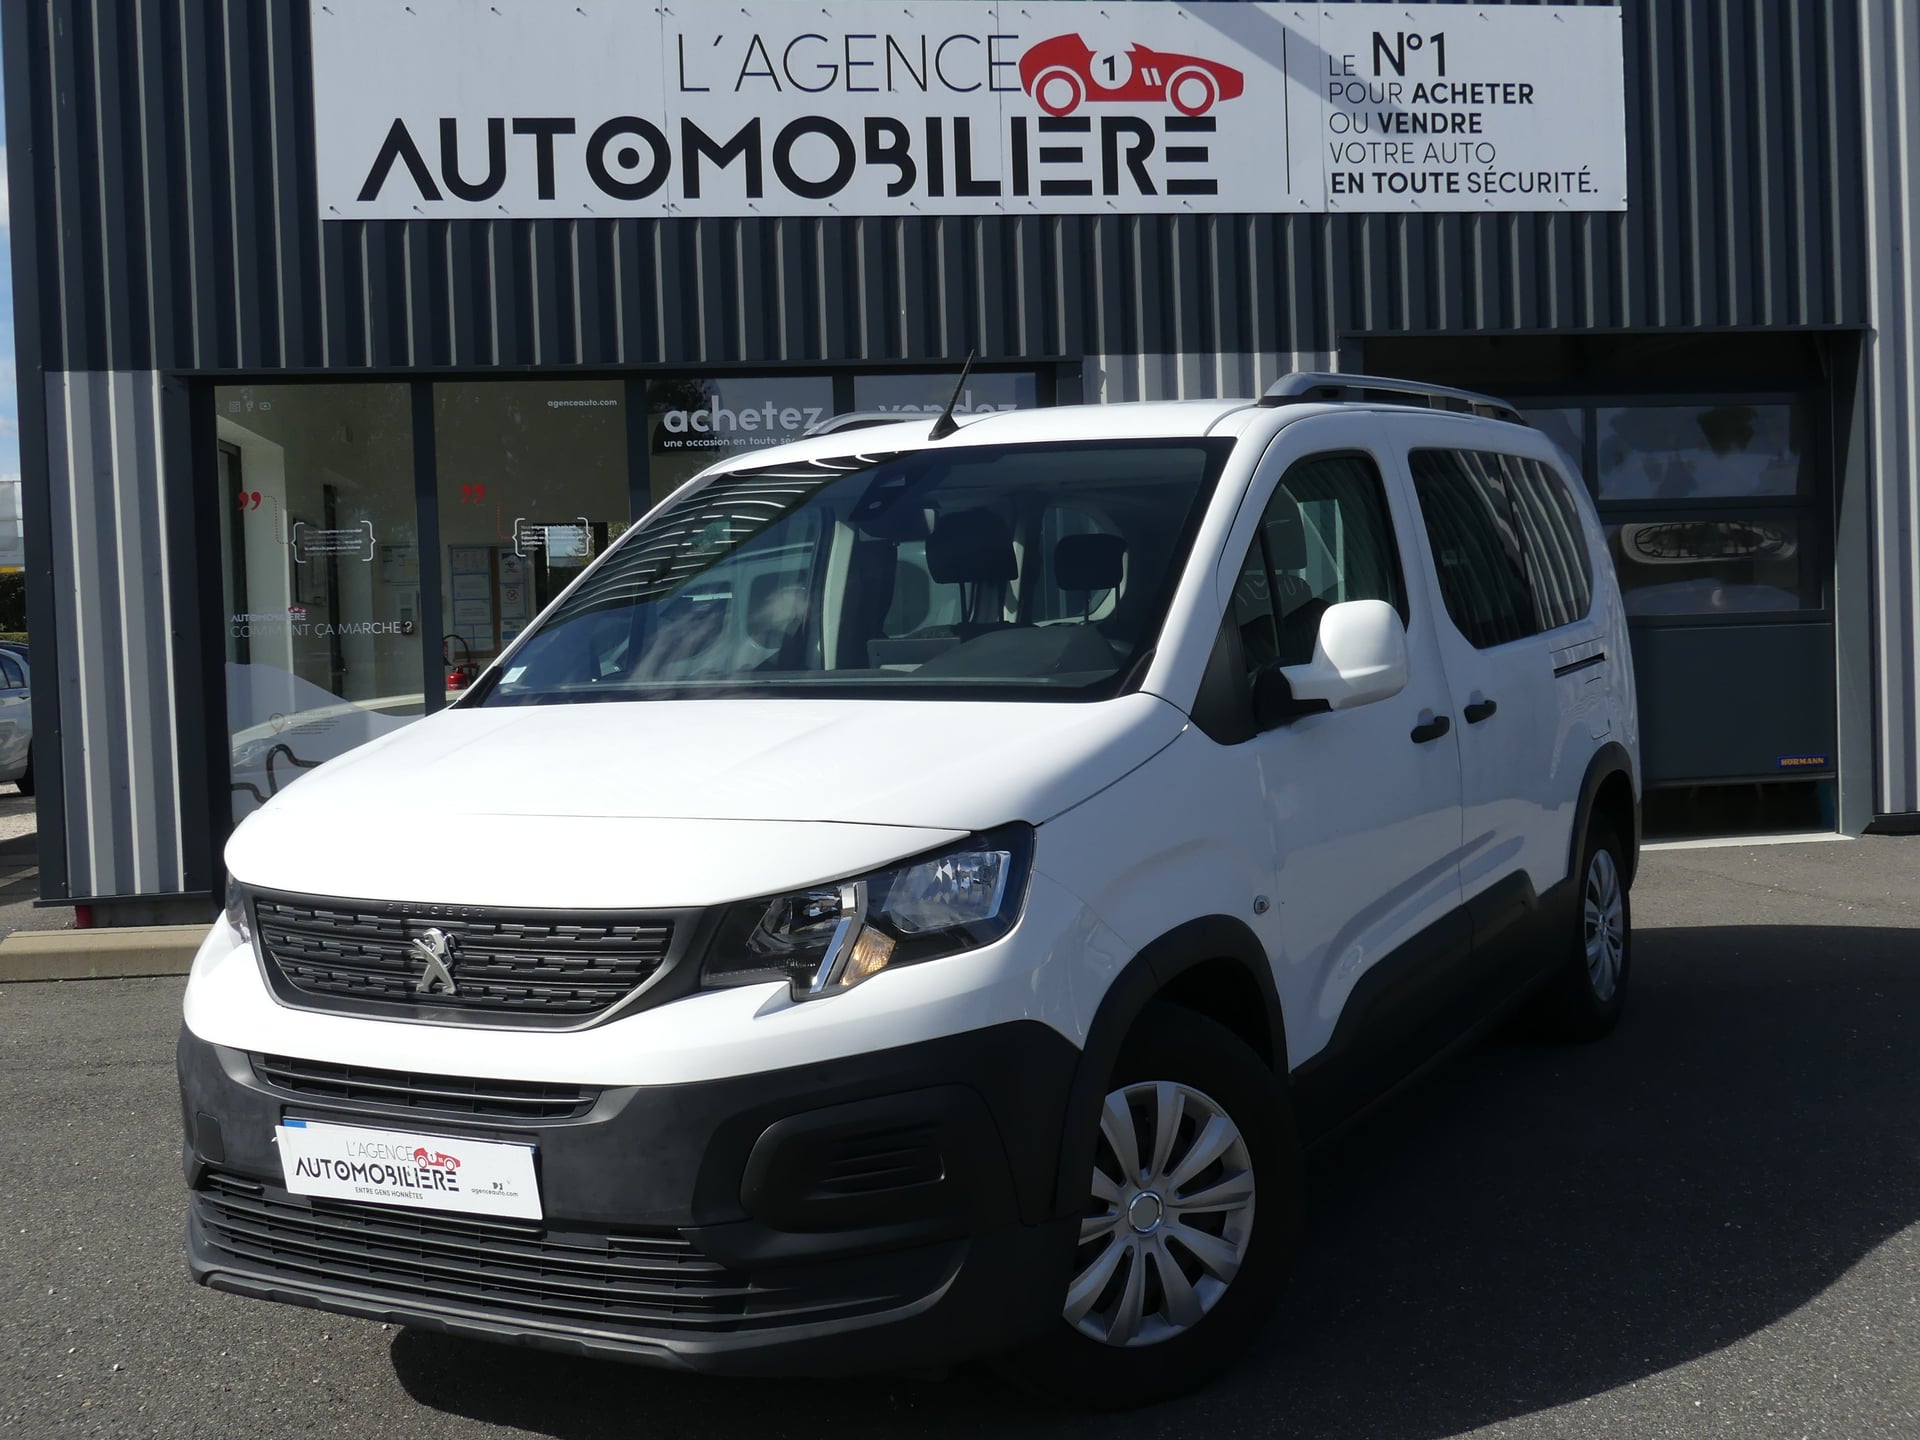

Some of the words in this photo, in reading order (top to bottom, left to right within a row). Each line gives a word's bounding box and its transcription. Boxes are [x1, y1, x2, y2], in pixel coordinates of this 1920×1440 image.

[679, 33, 1021, 92] L'AGENCE
[1103, 55, 1116, 81] 1
[1329, 55, 1356, 76] LE
[1329, 82, 1402, 104] POUR
[1411, 83, 1534, 104] ACHETER
[1329, 112, 1368, 133] OU
[1378, 112, 1482, 133] VENDRE
[357, 115, 1218, 202] AUTOMOBILIERE
[1329, 142, 1415, 163] VOTRE
[1423, 142, 1496, 163] AUTO
[1332, 172, 1364, 193] EN
[1372, 172, 1460, 193] TOUTE
[1467, 165, 1598, 193] SÉCURITÉ.
[547, 399, 618, 409] agenceauto.com
[664, 396, 823, 433] achetez
[664, 438, 683, 448] une
[686, 436, 730, 447] occasion
[733, 438, 746, 446] en
[749, 435, 777, 446] toute
[230, 623, 311, 638] COMMNT
[314, 623, 335, 638] ÇA
[386, 902, 485, 917] PEUGEOT
[346, 1140, 415, 1162] L'AGENCE
[296, 1156, 460, 1192] AUTOMOBILIERE
[355, 1186, 374, 1195] ENTRE
[374, 1188, 391, 1197] GENS
